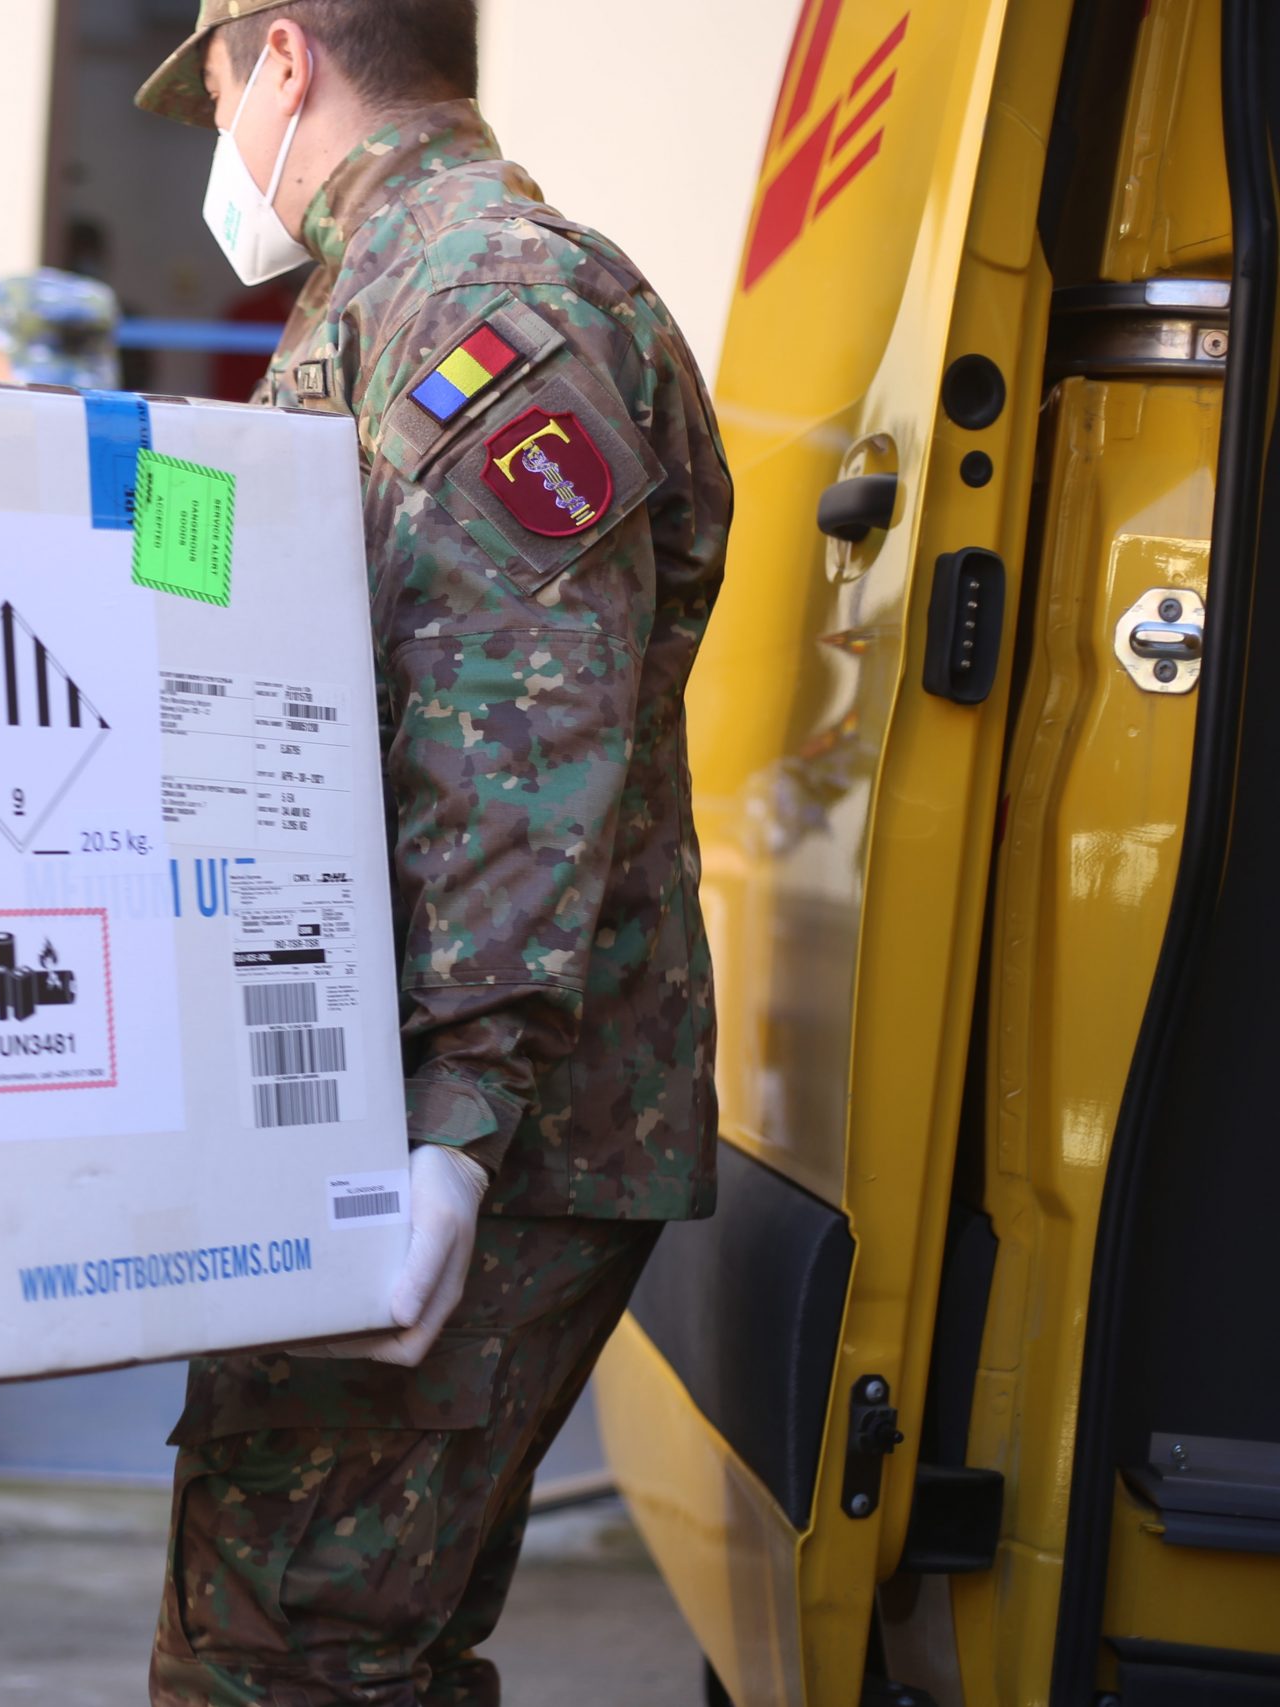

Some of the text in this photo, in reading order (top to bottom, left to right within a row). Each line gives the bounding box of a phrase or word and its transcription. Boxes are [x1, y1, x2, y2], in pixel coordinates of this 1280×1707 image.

[154, 495, 165, 549] ACCEPTED
[179, 510, 188, 547] GOODS
[189, 499, 200, 563] DANGEROUS
[210, 498, 222, 576] SERVICE ALERT
[12, 788, 25, 809] 9
[81, 829, 154, 855] 20.5 kg.
[19, 1238, 312, 1302] WWW.SOFTBOXSYSTEMS.COM
